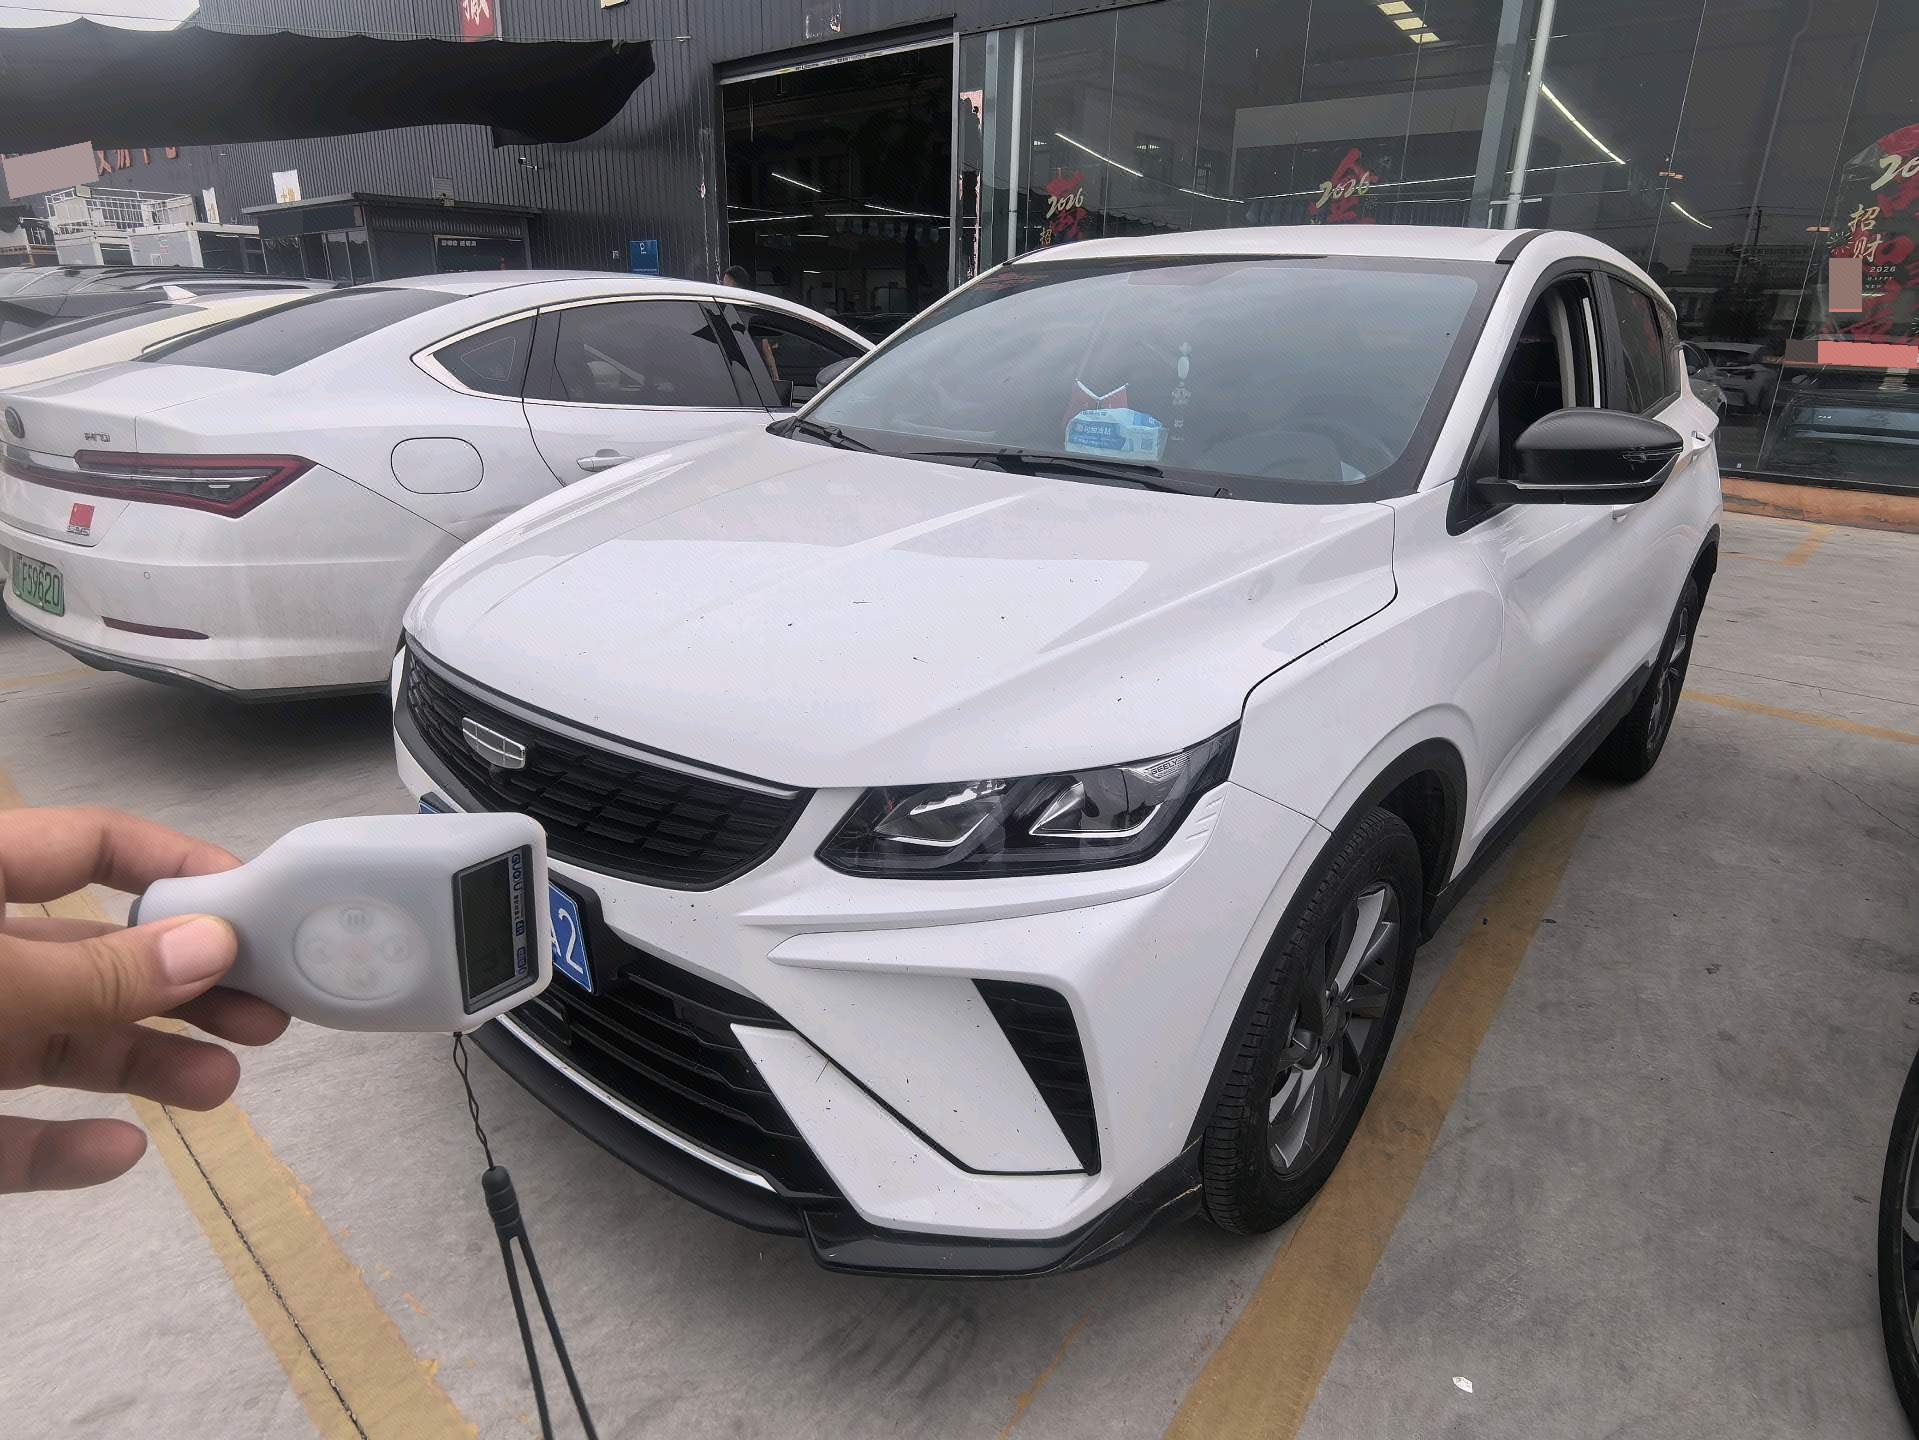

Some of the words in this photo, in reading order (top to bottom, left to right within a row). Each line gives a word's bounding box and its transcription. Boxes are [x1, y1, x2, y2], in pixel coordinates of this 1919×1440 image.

[1046, 187, 1083, 219] 2026
[1316, 171, 1369, 209] 2026
[1151, 759, 1178, 775] GEELY
